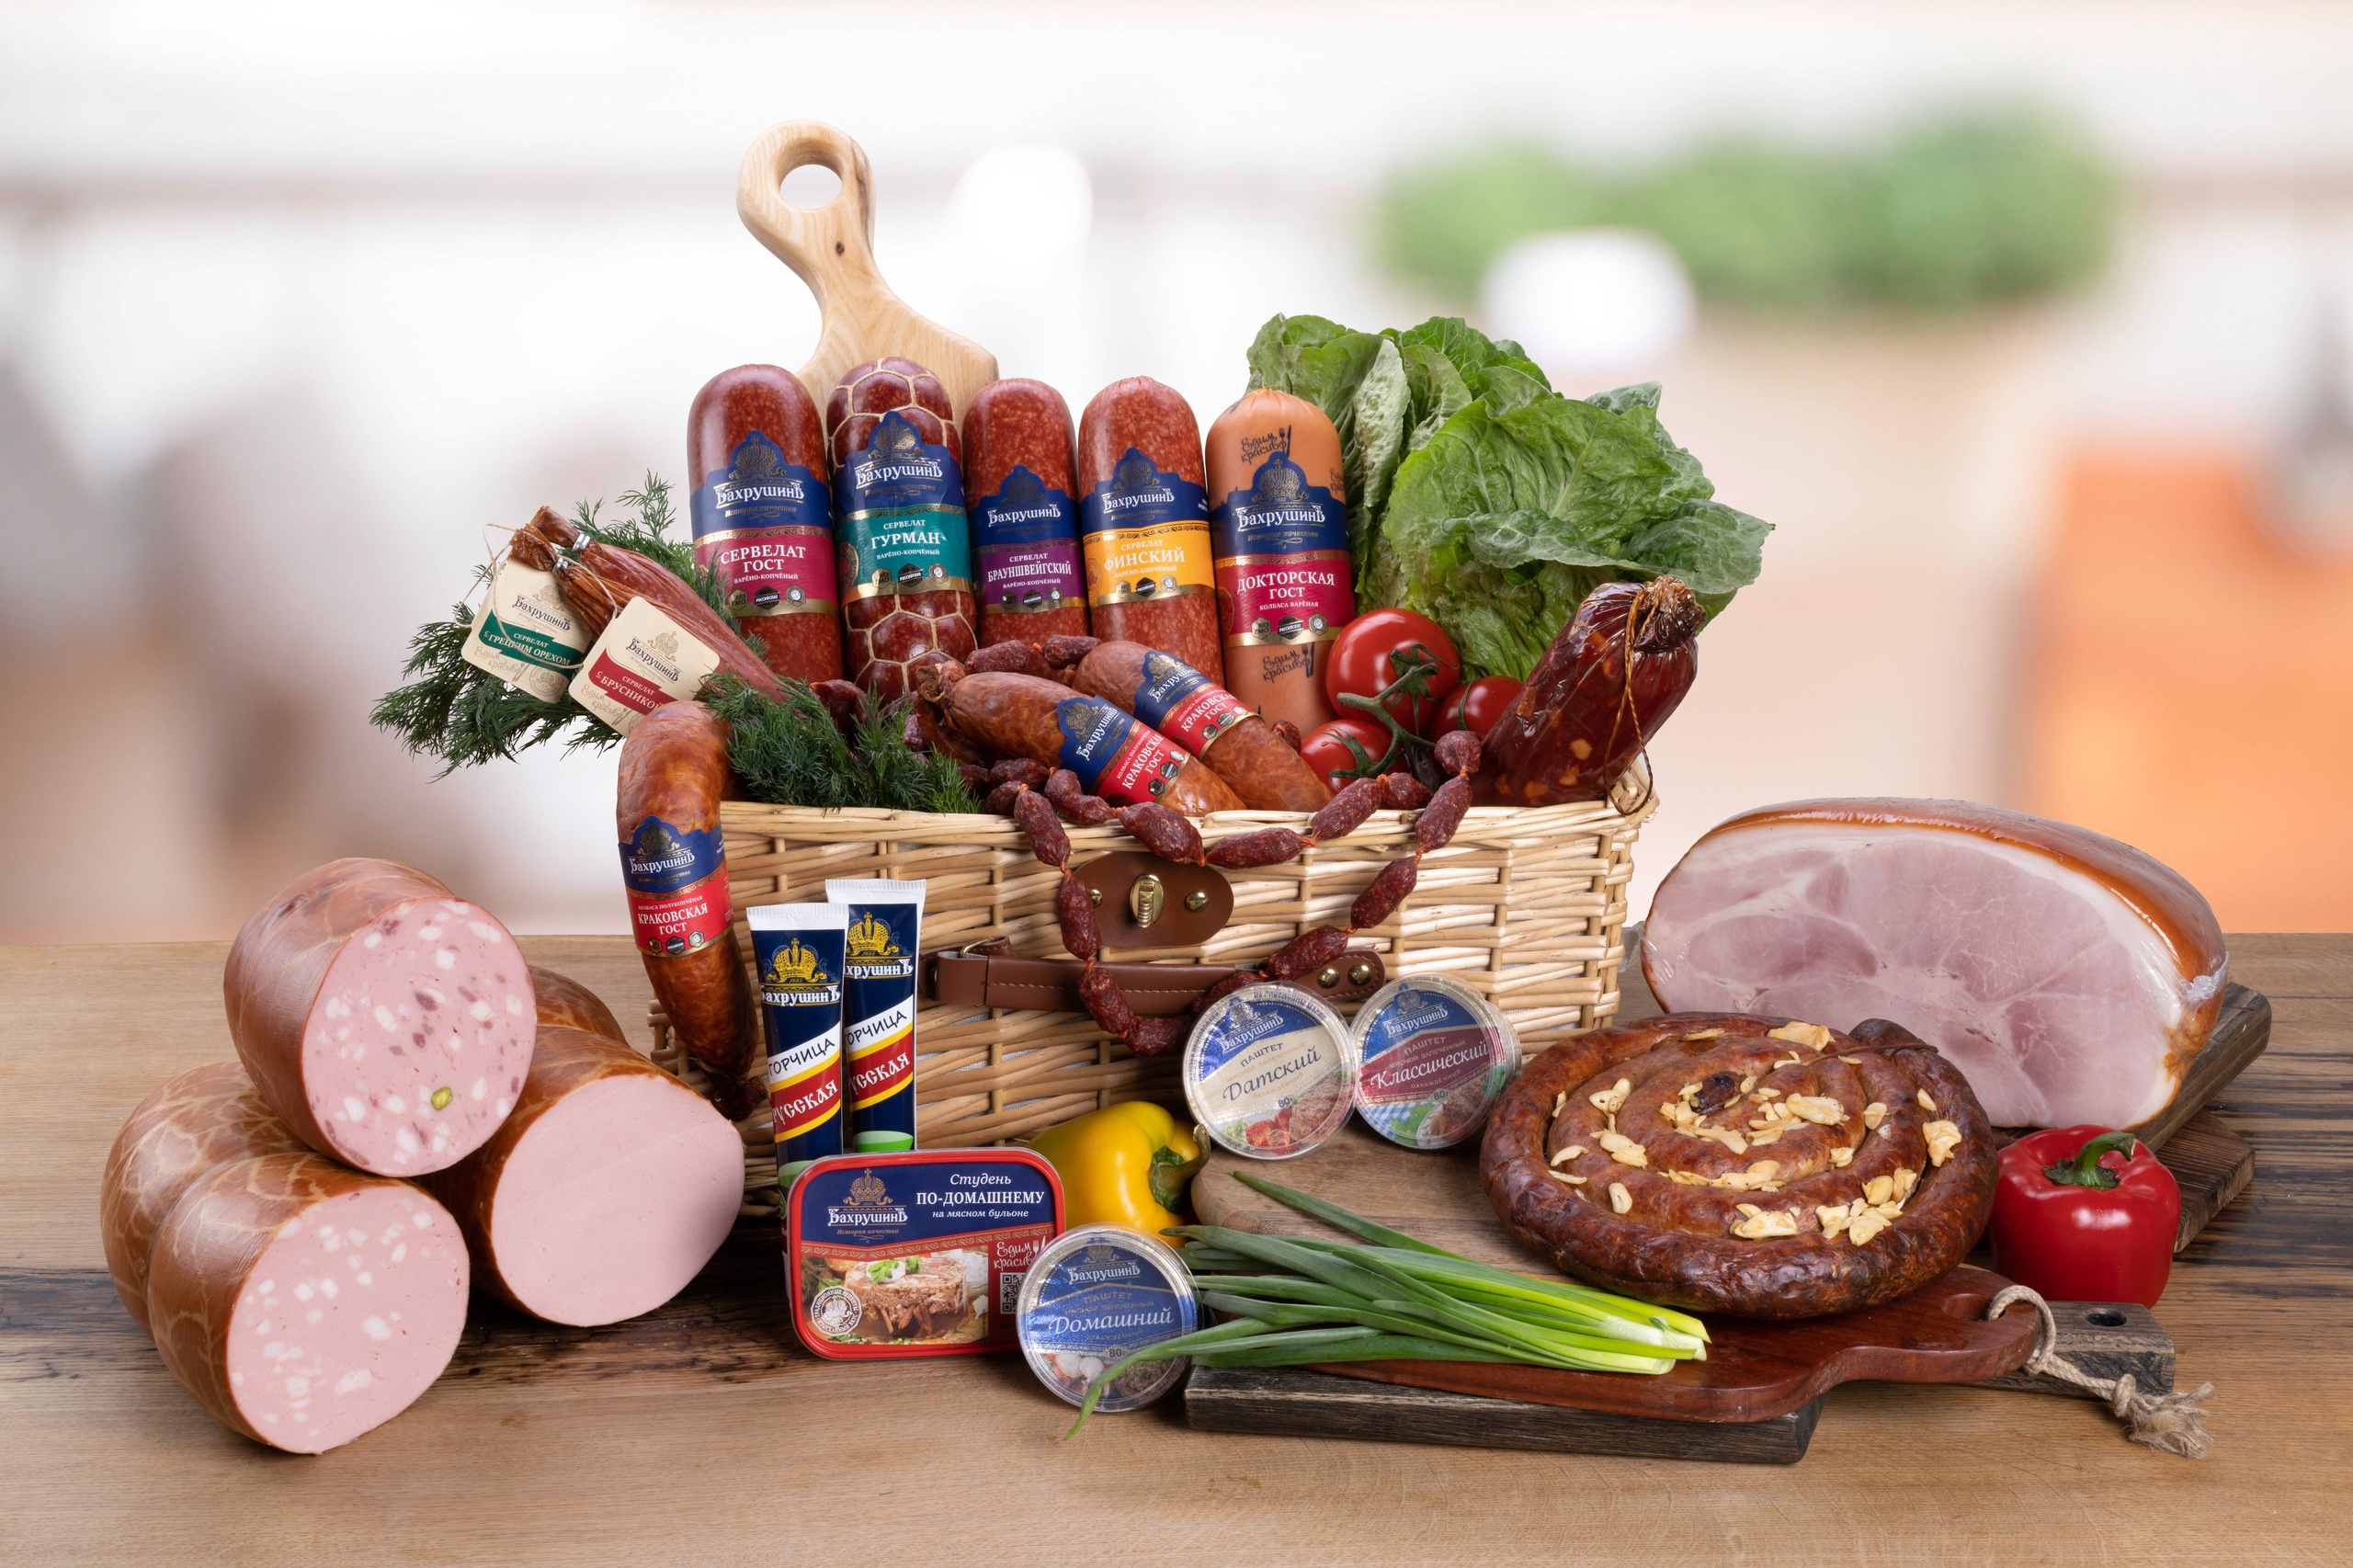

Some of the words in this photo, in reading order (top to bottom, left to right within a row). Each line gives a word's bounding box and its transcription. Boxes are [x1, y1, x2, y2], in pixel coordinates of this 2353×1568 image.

[1241, 432, 1277, 451] Едим
[1241, 440, 1287, 465] красиво
[883, 519, 926, 530] СЕРВЕЛАТ
[870, 531, 940, 550] ГУРМАН
[1120, 540, 1164, 551] СЕРВЕЛАТ
[721, 544, 805, 564] СЕРВЕЛАТ
[876, 548, 940, 560] ВАРЁНО-КОПЧЁНЫЙ
[1009, 553, 1048, 562] СЕРВЕЛАТ
[1104, 547, 1186, 571] ФИНСКИЙ
[744, 559, 784, 573] ГОСТ
[987, 561, 1072, 582] БРАУНШВЕЙГСКИЙ
[1114, 564, 1177, 578] ВАРЁНО-КОПЧЁНЫЙ
[733, 573, 799, 585] ВАРЁНО-КОПЧЁНЫЙ
[1003, 577, 1061, 588] ВАРЁНО-КОПЧЁНЫЙ
[1236, 572, 1335, 595] ДОКТОРСКАЯ
[1269, 587, 1305, 599] ГОСТ
[1259, 602, 1289, 610] КОЛБАСА
[514, 632, 550, 648] СЕРВЕЛАТ
[474, 646, 506, 664] Едим
[534, 649, 571, 665] ОРЕХОМ
[1262, 650, 1300, 671] Едим
[1262, 657, 1311, 683] красиво
[581, 684, 611, 707] Едим
[622, 676, 655, 696] СЕРВЕЛАТ
[1181, 693, 1237, 733] КРАКОВСКАЯ
[1204, 702, 1227, 721] ГОСТ
[1122, 733, 1164, 790] КРАКОВСКАЯ
[1144, 749, 1165, 774] ГОСТ
[637, 903, 709, 925] КРАКОВСКАЯ
[659, 922, 688, 935] ГОСТ
[845, 1010, 907, 1046] ОРЧИЦА
[1240, 1042, 1283, 1067] ПАШТЕТ
[1389, 1056, 1419, 1068] МЯСНОЙ
[1420, 1040, 1466, 1058] ЗАПЕЧЕННЫЙ
[1404, 1036, 1447, 1055] ПАШТЕТ
[768, 1038, 835, 1077] ГОРЧИЦА
[1226, 1066, 1257, 1083] МЯСНОЙ
[1257, 1041, 1306, 1068] ЗАПЕЧЕННЫЙ
[1370, 1040, 1490, 1089] Классический
[850, 1051, 911, 1096] УССКАЯ
[1222, 1045, 1322, 1101] Датский
[1411, 1069, 1461, 1089] ОХЛАЖДЁННЫЙ
[1252, 1072, 1304, 1099] ОХЛАЖДЁННЫЙ
[772, 1079, 838, 1126] РУССКАЯ
[949, 1173, 1012, 1187] Студень
[916, 1191, 1045, 1207] ПО-ДОМАШНЕМУ
[946, 1210, 986, 1218] мясном
[988, 1209, 1029, 1219] бульоне
[836, 1229, 867, 1237] История
[996, 1241, 1031, 1258] Едим
[994, 1251, 1035, 1272] красив
[1064, 1305, 1098, 1315] МЯСНОЙ
[1102, 1301, 1154, 1311] ЗАПЕЧЕННЫЙ
[1084, 1291, 1133, 1305] ПАШТЕТ
[1048, 1306, 1174, 1335] Домашний
